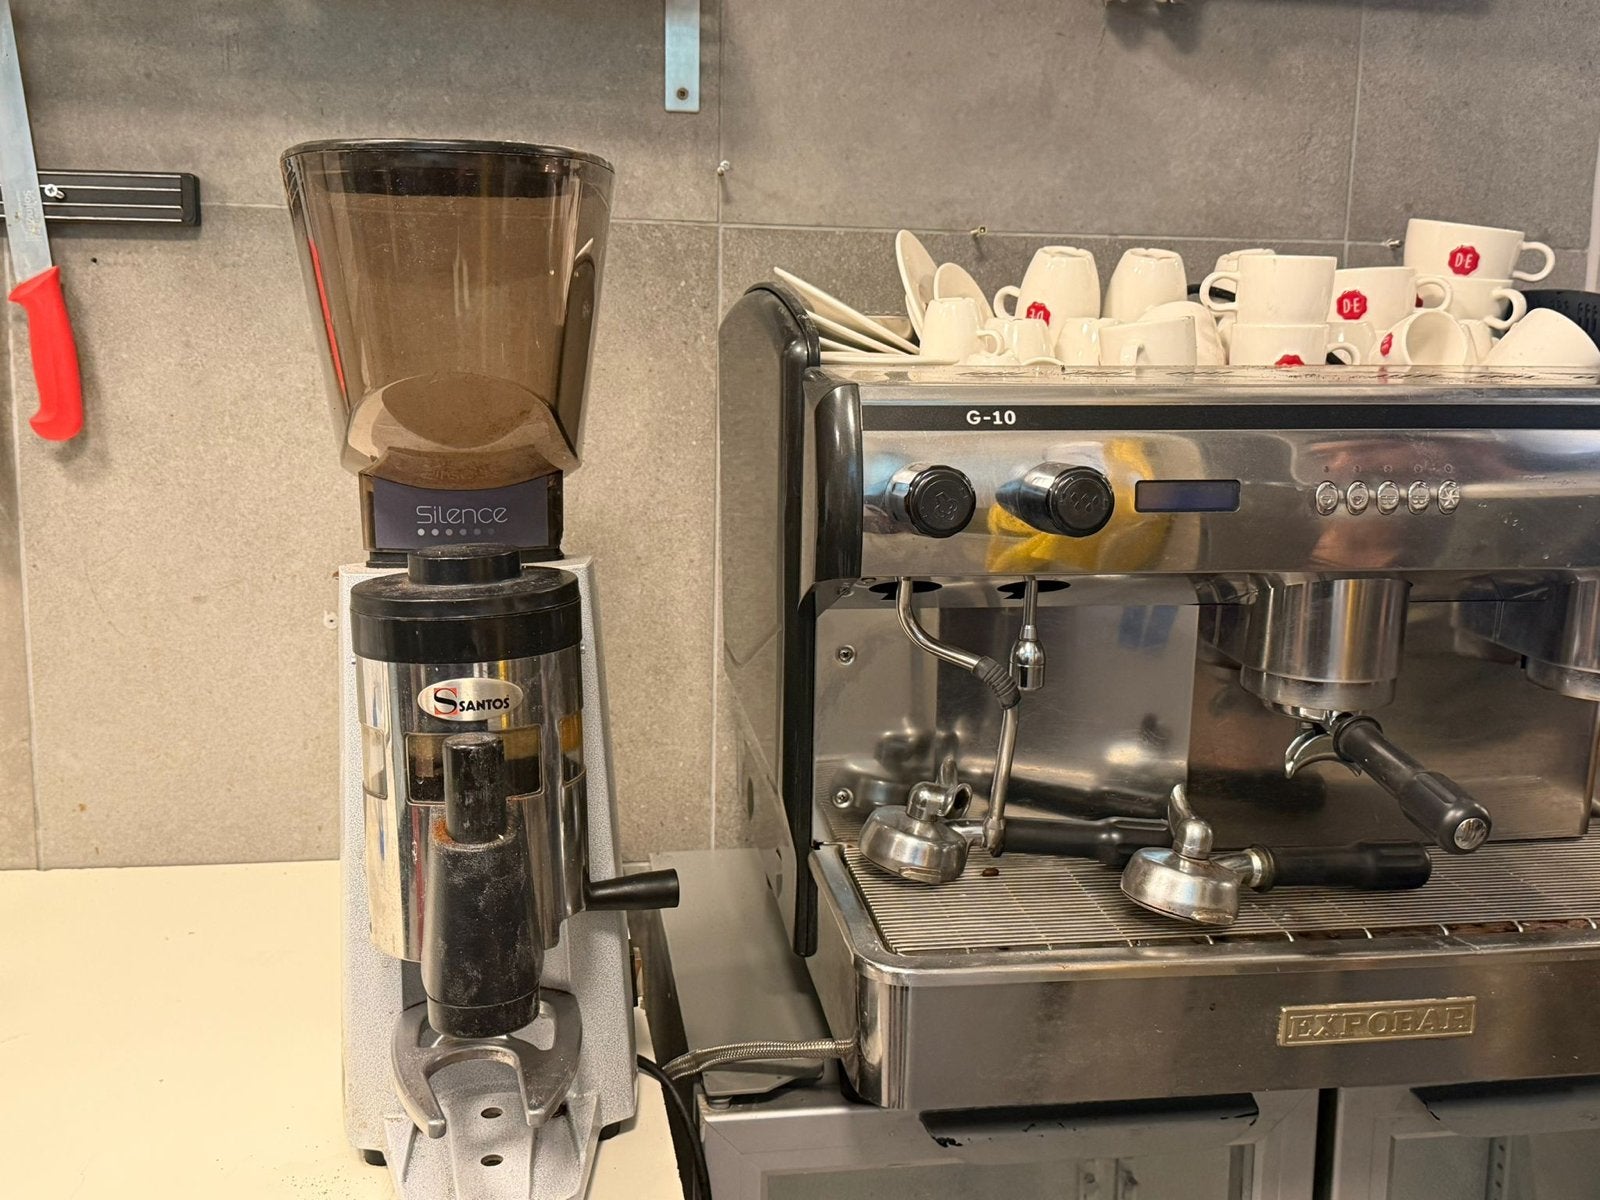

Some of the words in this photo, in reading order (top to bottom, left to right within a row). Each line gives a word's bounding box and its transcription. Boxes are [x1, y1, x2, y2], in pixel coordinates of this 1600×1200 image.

[966, 410, 1016, 425] G-10
[416, 505, 508, 524] Silence
[459, 698, 510, 713] SANTOS
[1287, 1006, 1470, 1039] EXPOBAR
